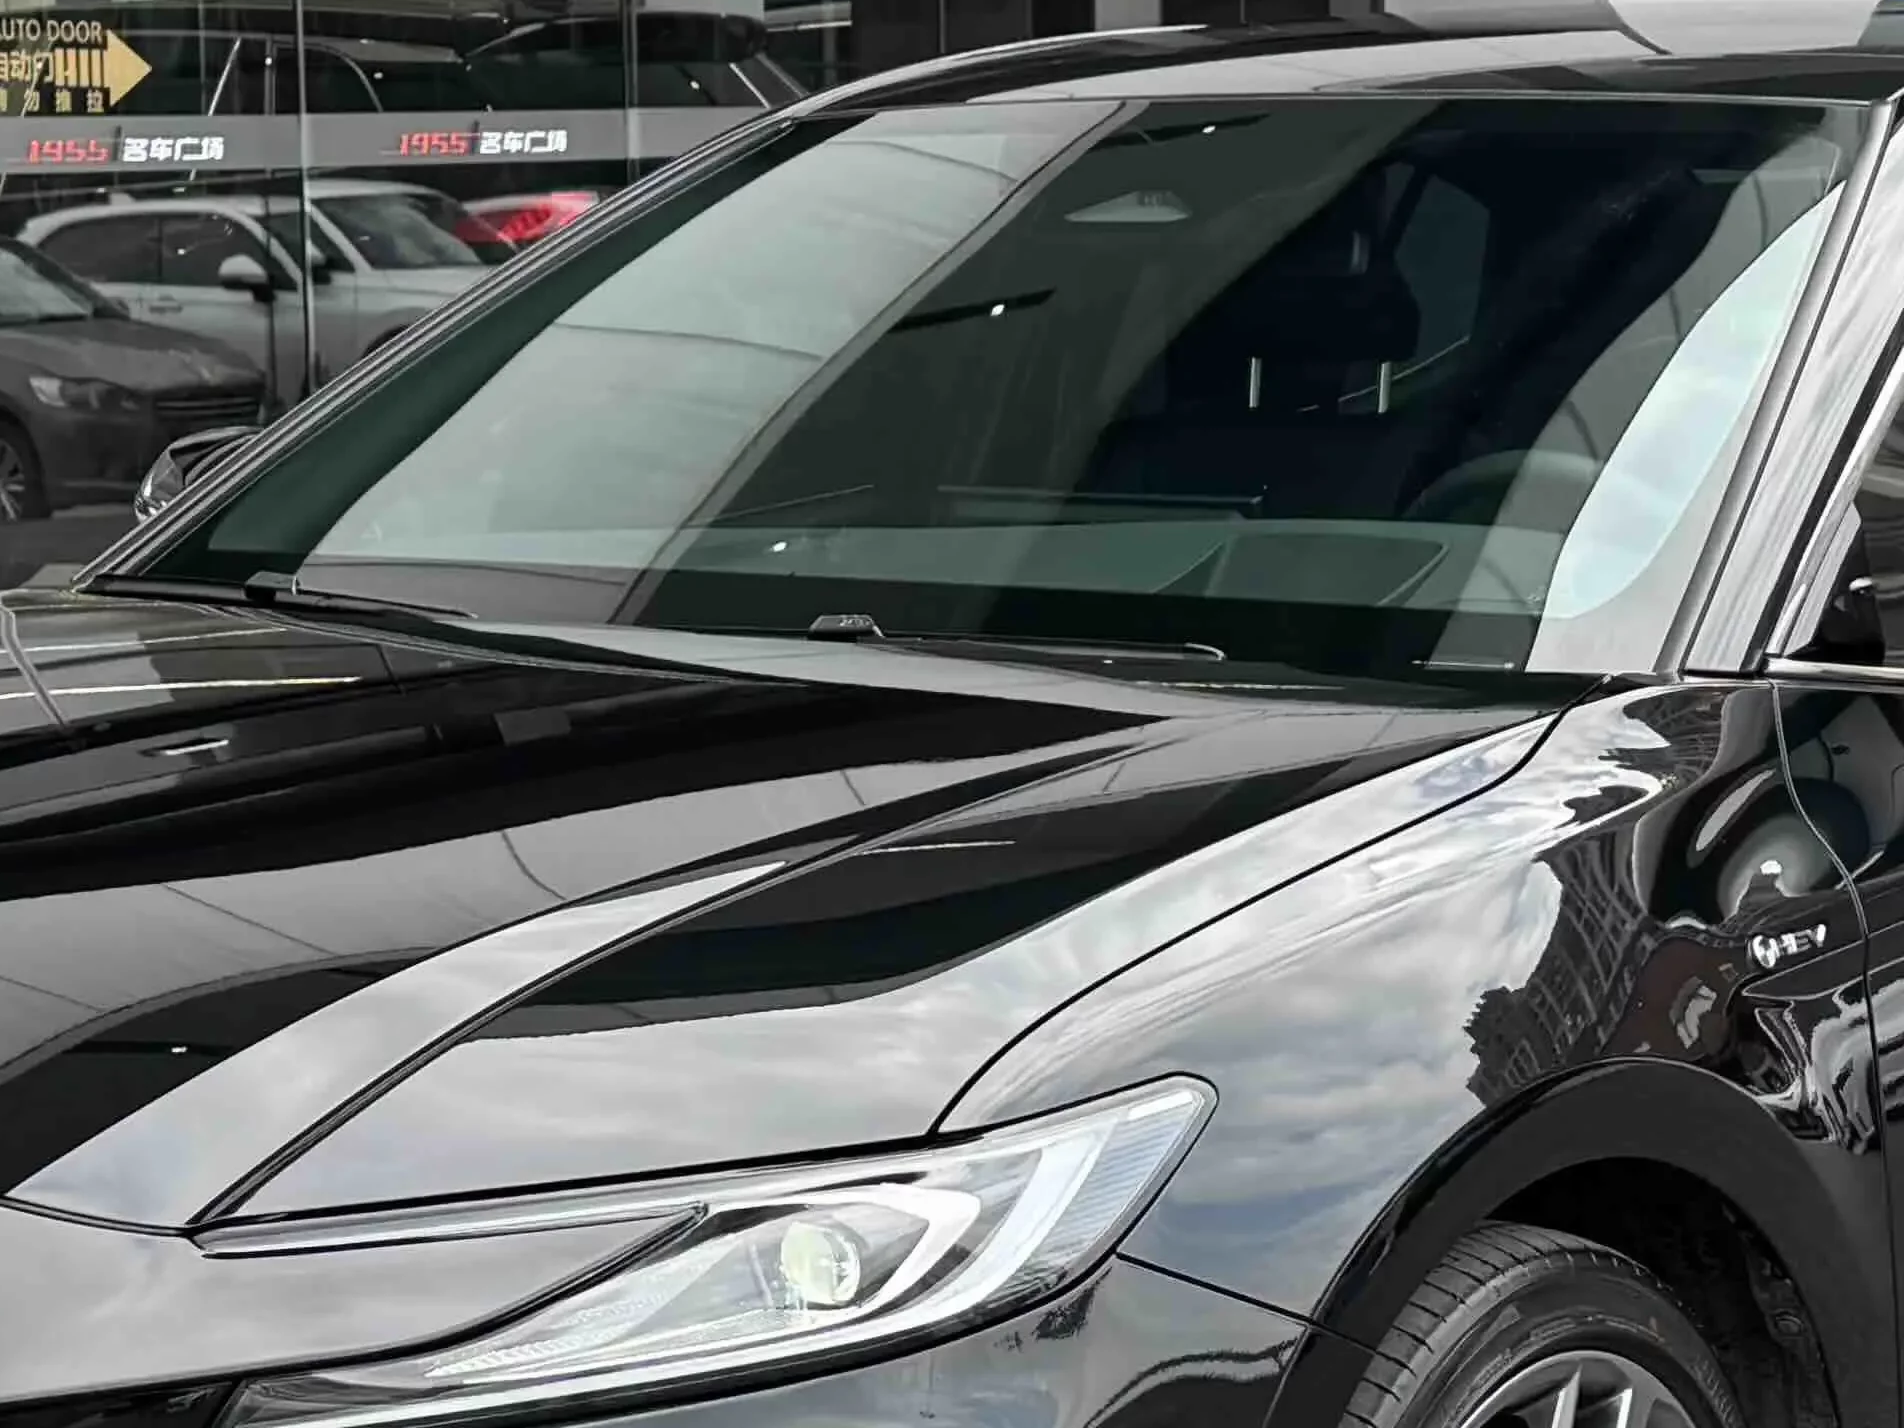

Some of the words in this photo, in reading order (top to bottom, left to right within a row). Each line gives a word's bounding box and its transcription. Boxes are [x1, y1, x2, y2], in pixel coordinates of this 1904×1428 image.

[47, 20, 103, 44] DOOR
[28, 139, 109, 162] 1955
[122, 136, 225, 162] 名车广场
[399, 131, 469, 156] 1955
